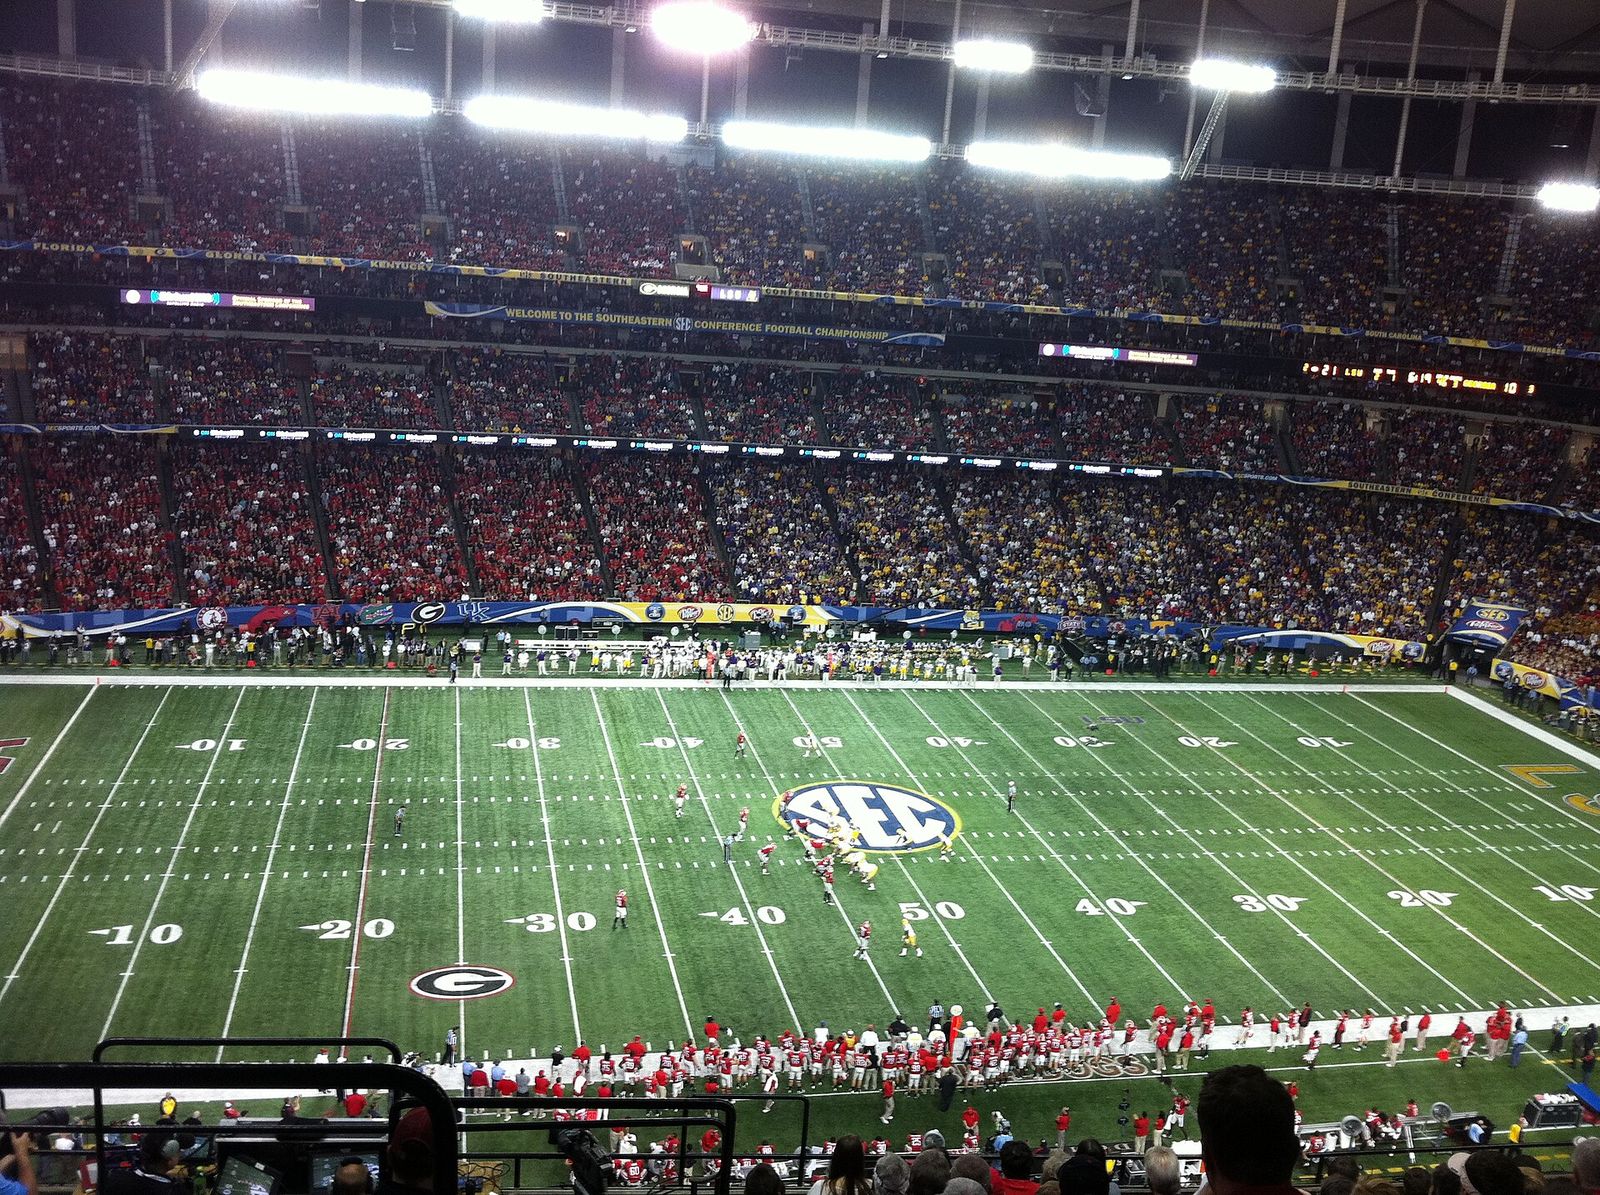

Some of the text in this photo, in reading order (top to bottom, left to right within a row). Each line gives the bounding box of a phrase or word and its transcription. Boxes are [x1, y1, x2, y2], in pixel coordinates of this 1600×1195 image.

[33, 242, 95, 252] FLORIDA
[205, 251, 267, 262] GEORGIA
[370, 260, 433, 271] KENTUCKY
[540, 272, 628, 285] SOUTHEASTERN
[765, 287, 836, 299] CONFERENCE
[505, 308, 889, 341] WELCOME TO THE SOUTHEASTERN SEC CONFERENCE FOOTBALL CHAMPIONSHIP
[1220, 319, 1281, 330] MISSISSIPPI STATE
[1365, 330, 1422, 341] SOUTH CAROLINA
[1522, 344, 1566, 355] TENNESSEE
[1348, 482, 1411, 495] SOUTHEASTERN
[1432, 490, 1491, 504] CONFERENCE
[717, 605, 734, 620] SEC
[1478, 608, 1507, 621] SEC
[191, 739, 248, 751] 10
[352, 738, 410, 750] 20
[507, 737, 561, 750] 30
[652, 737, 704, 749] 40
[792, 736, 843, 748] 50
[925, 737, 974, 748] 40
[1053, 736, 1105, 748] 30
[1177, 736, 1230, 748] 20
[1296, 736, 1348, 748] 10
[783, 783, 950, 849] SEC
[1387, 890, 1452, 908] 20
[1532, 884, 1595, 902] 10
[1075, 898, 1138, 916] 40
[1232, 893, 1299, 913] 30
[719, 906, 787, 926] 40
[898, 901, 966, 921] 50
[319, 918, 395, 939] 20
[525, 912, 597, 933] 30
[106, 924, 183, 944] 10
[411, 966, 511, 998] G
